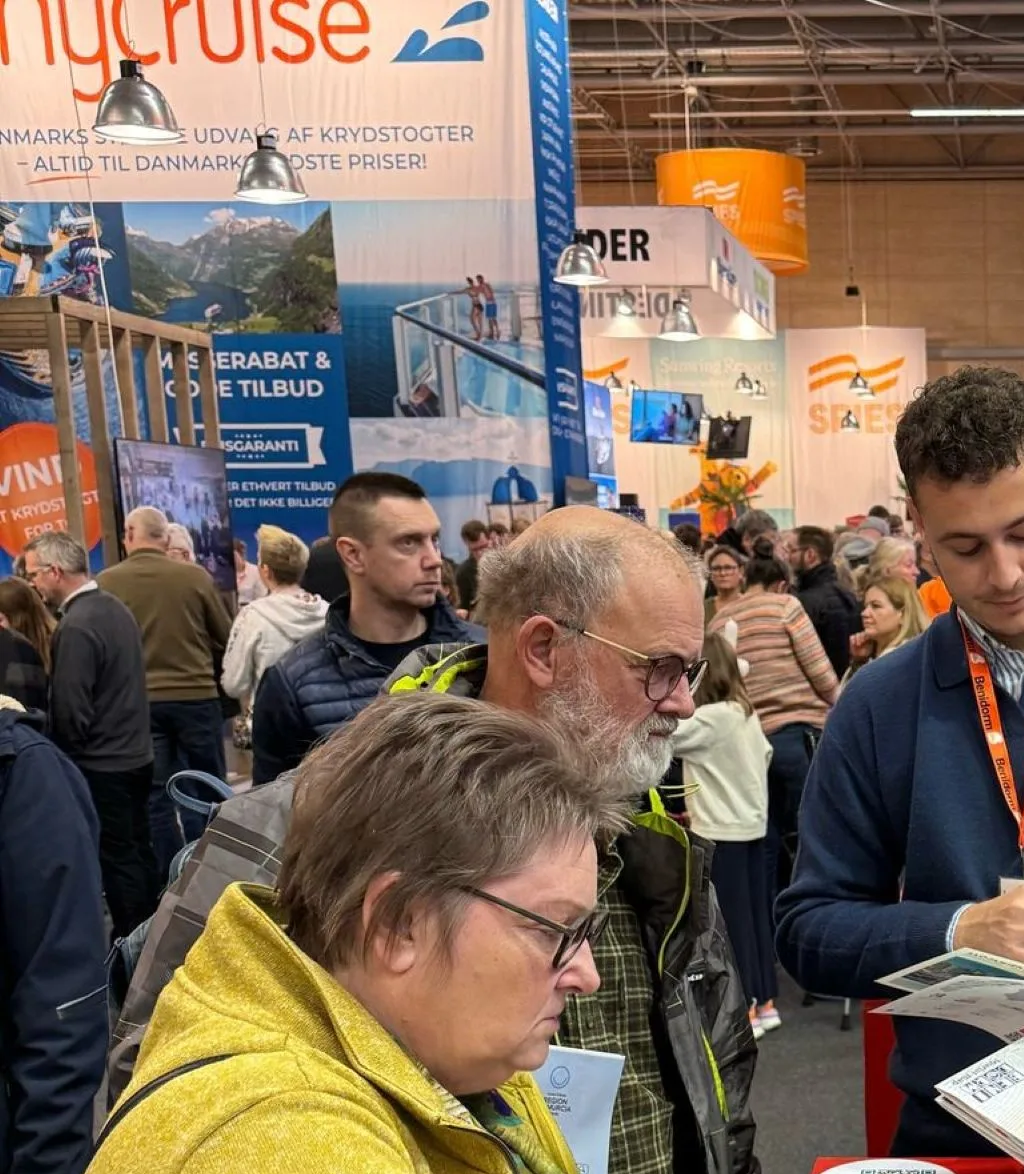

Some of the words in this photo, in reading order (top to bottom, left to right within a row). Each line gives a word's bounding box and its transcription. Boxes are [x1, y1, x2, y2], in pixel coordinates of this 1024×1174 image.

[287, 127, 313, 142] AF
[320, 125, 474, 142] KRYDSTOGTER
[34, 156, 93, 172] ALTID
[100, 155, 130, 171] TIL
[136, 154, 247, 171] DANMARK
[349, 154, 427, 169] PRISER!
[160, 351, 308, 369] MSERABAT
[316, 351, 331, 369] &
[238, 379, 324, 397] TILBUD
[0, 454, 82, 497] VIN
[242, 481, 290, 492] ETHVERT
[295, 480, 337, 491] TILBUD
[11, 490, 99, 521] KRYDSTGT
[235, 497, 255, 508] DET
[259, 497, 284, 508] IKKE
[974, 675, 993, 731] Benidorm
[996, 757, 1017, 812] Benidorm
